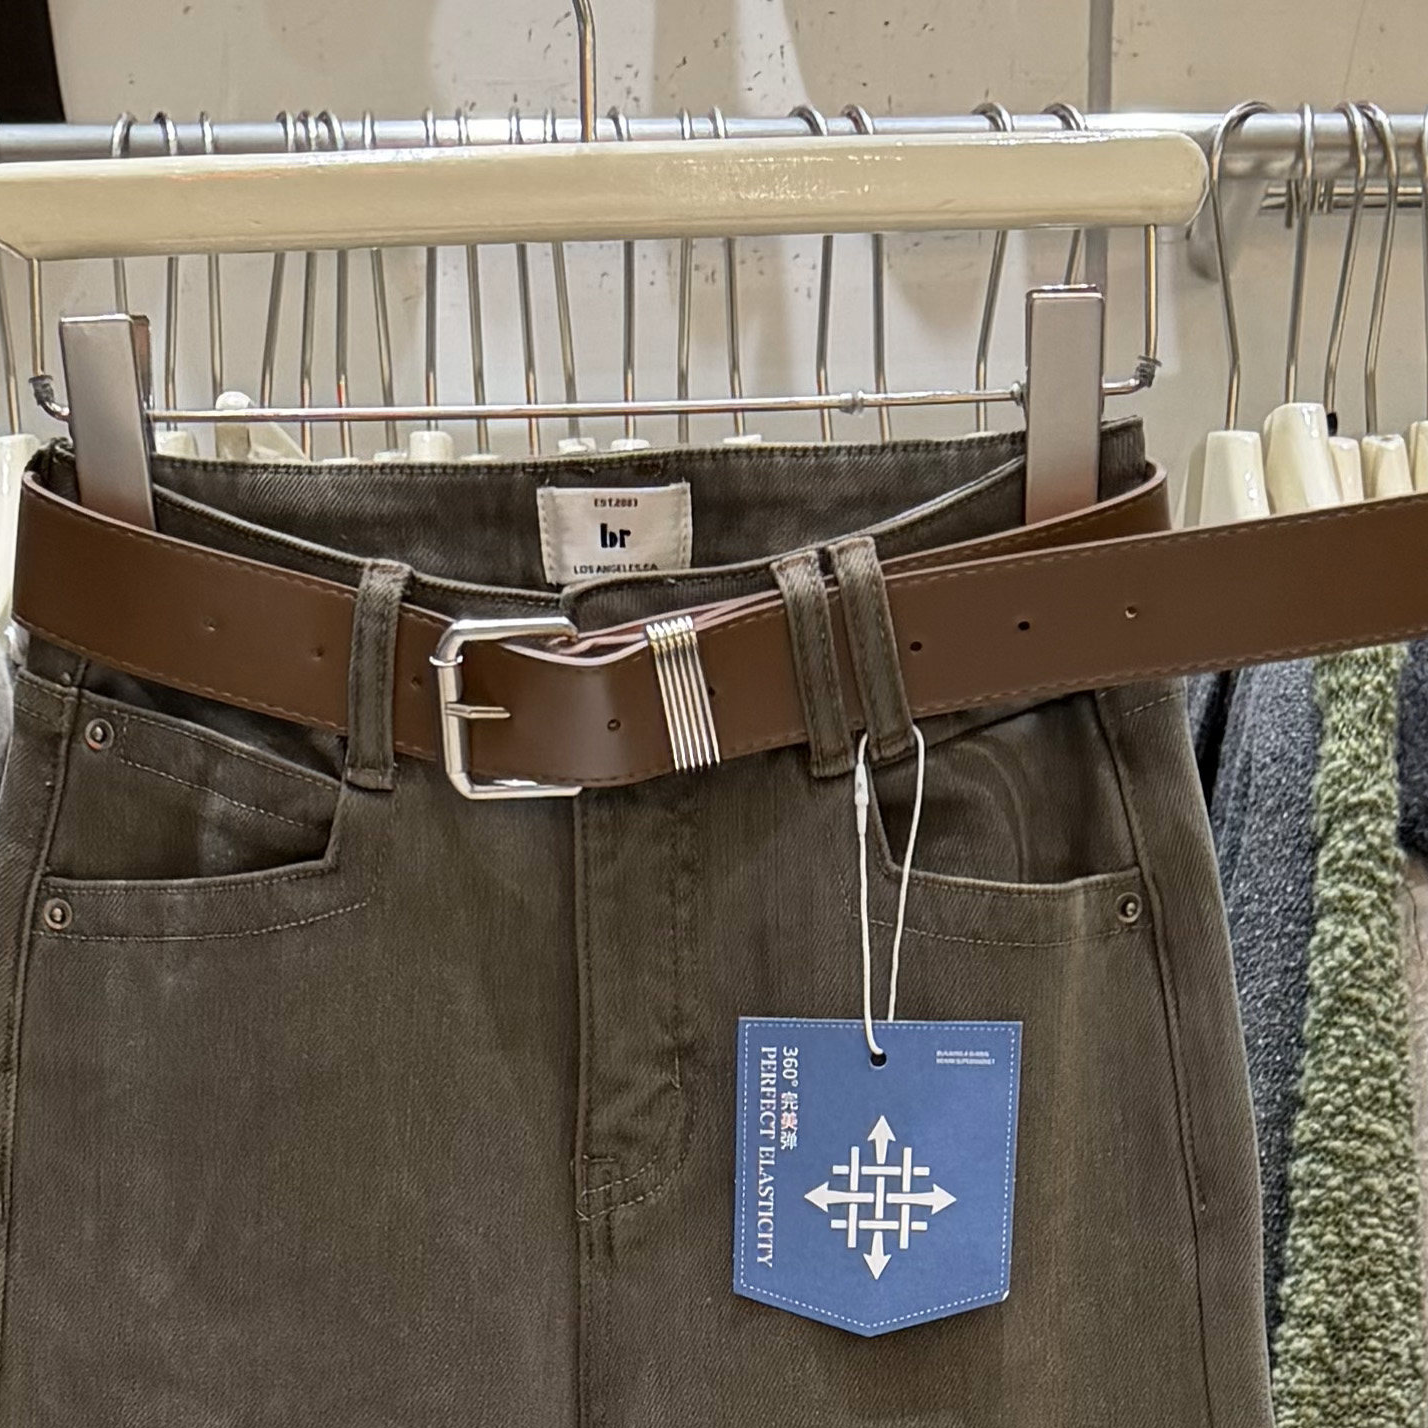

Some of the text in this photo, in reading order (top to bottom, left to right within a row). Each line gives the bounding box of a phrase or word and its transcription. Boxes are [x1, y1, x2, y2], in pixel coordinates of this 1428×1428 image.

[573, 565, 594, 575] LOS
[782, 1046, 799, 1087] 360°
[757, 1046, 777, 1268] PERFECT ELASTICITY
